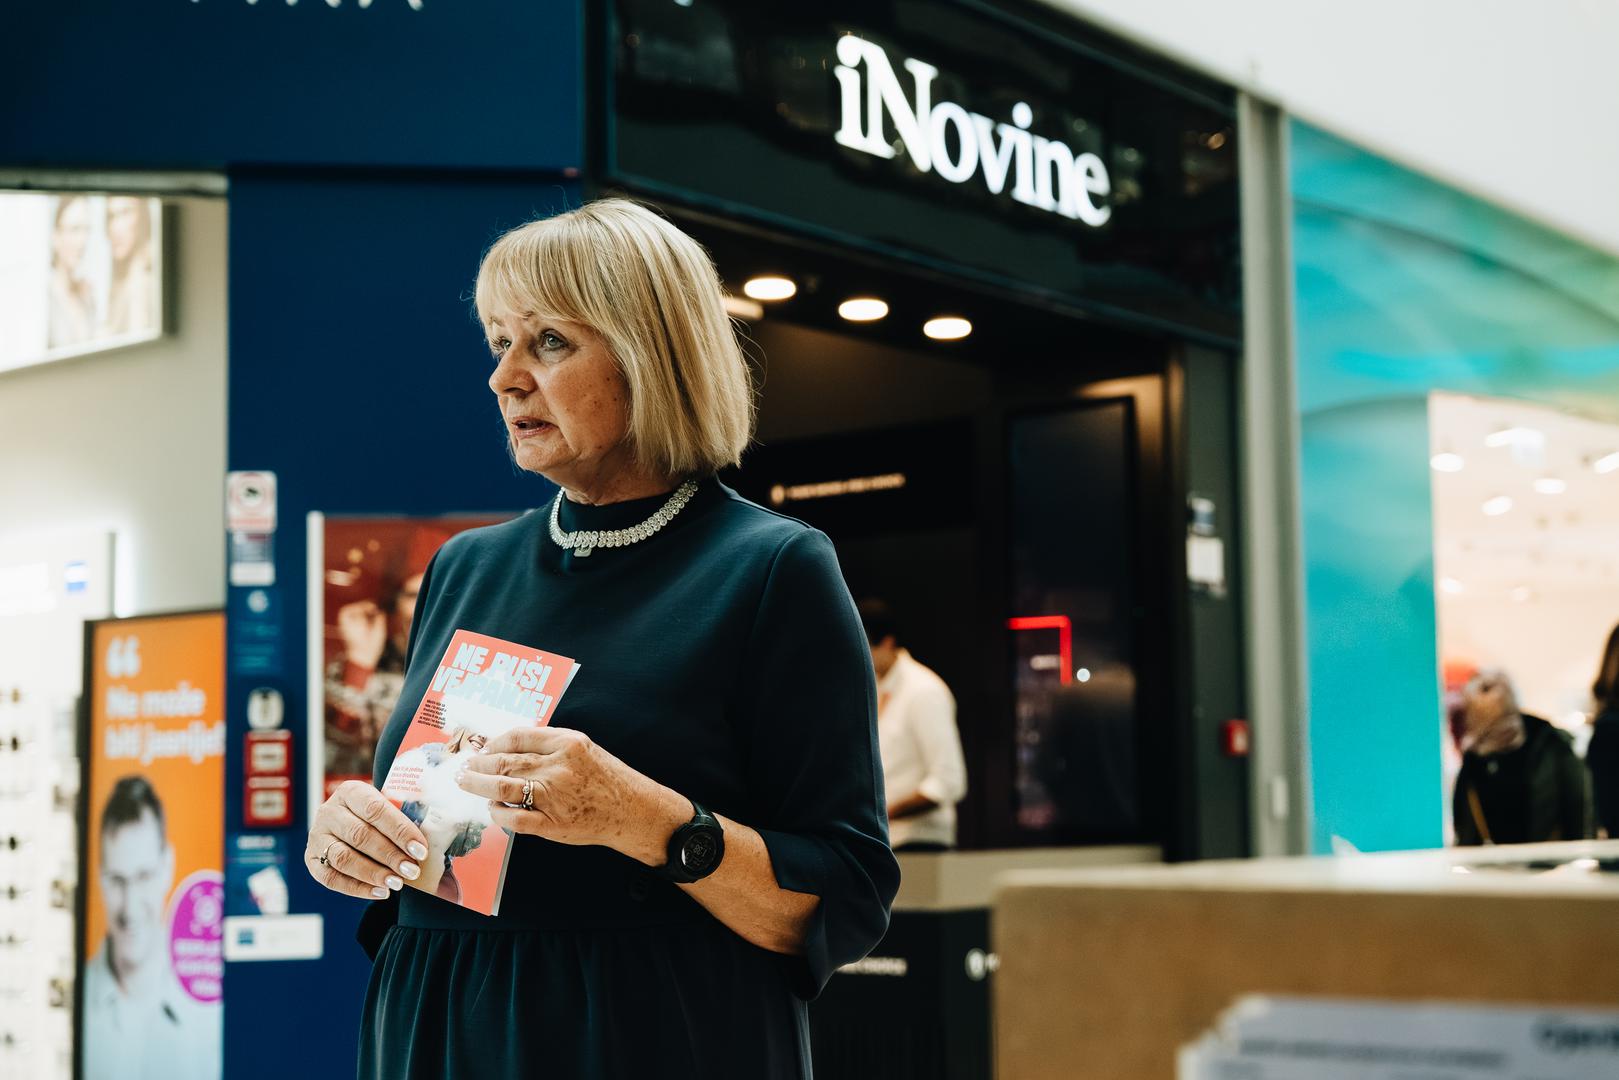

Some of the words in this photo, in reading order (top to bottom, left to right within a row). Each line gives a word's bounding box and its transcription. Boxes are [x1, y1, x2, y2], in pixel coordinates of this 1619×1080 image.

[834, 35, 1111, 227] iNovine
[452, 643, 489, 674] NE
[488, 652, 552, 692] PUŠI
